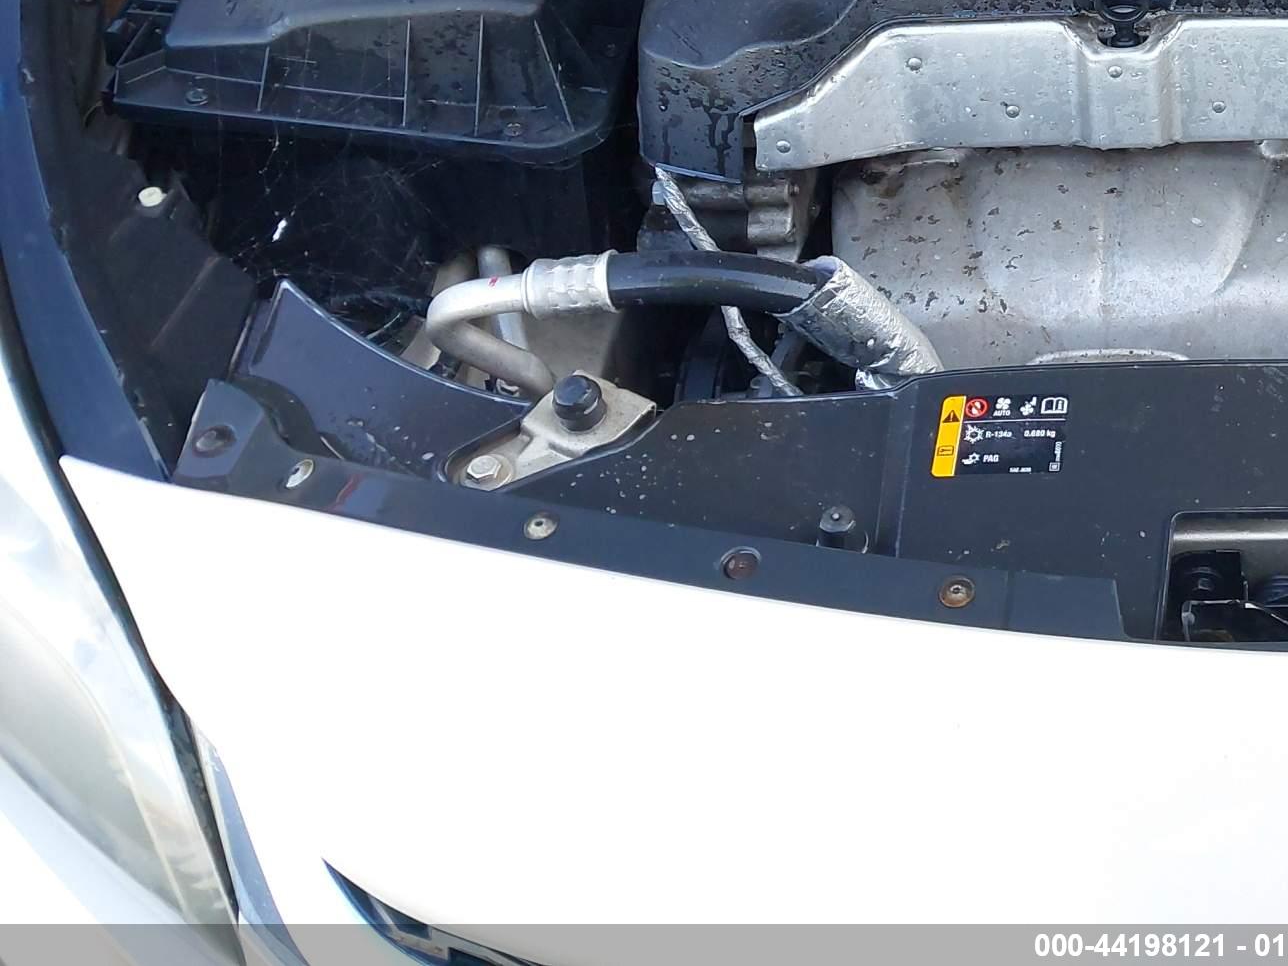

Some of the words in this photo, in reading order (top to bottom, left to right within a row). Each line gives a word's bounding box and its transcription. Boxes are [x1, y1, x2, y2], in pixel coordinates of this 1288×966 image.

[985, 430, 1013, 438] R-134a
[1046, 429, 1056, 438] kg
[983, 454, 999, 463] PAG
